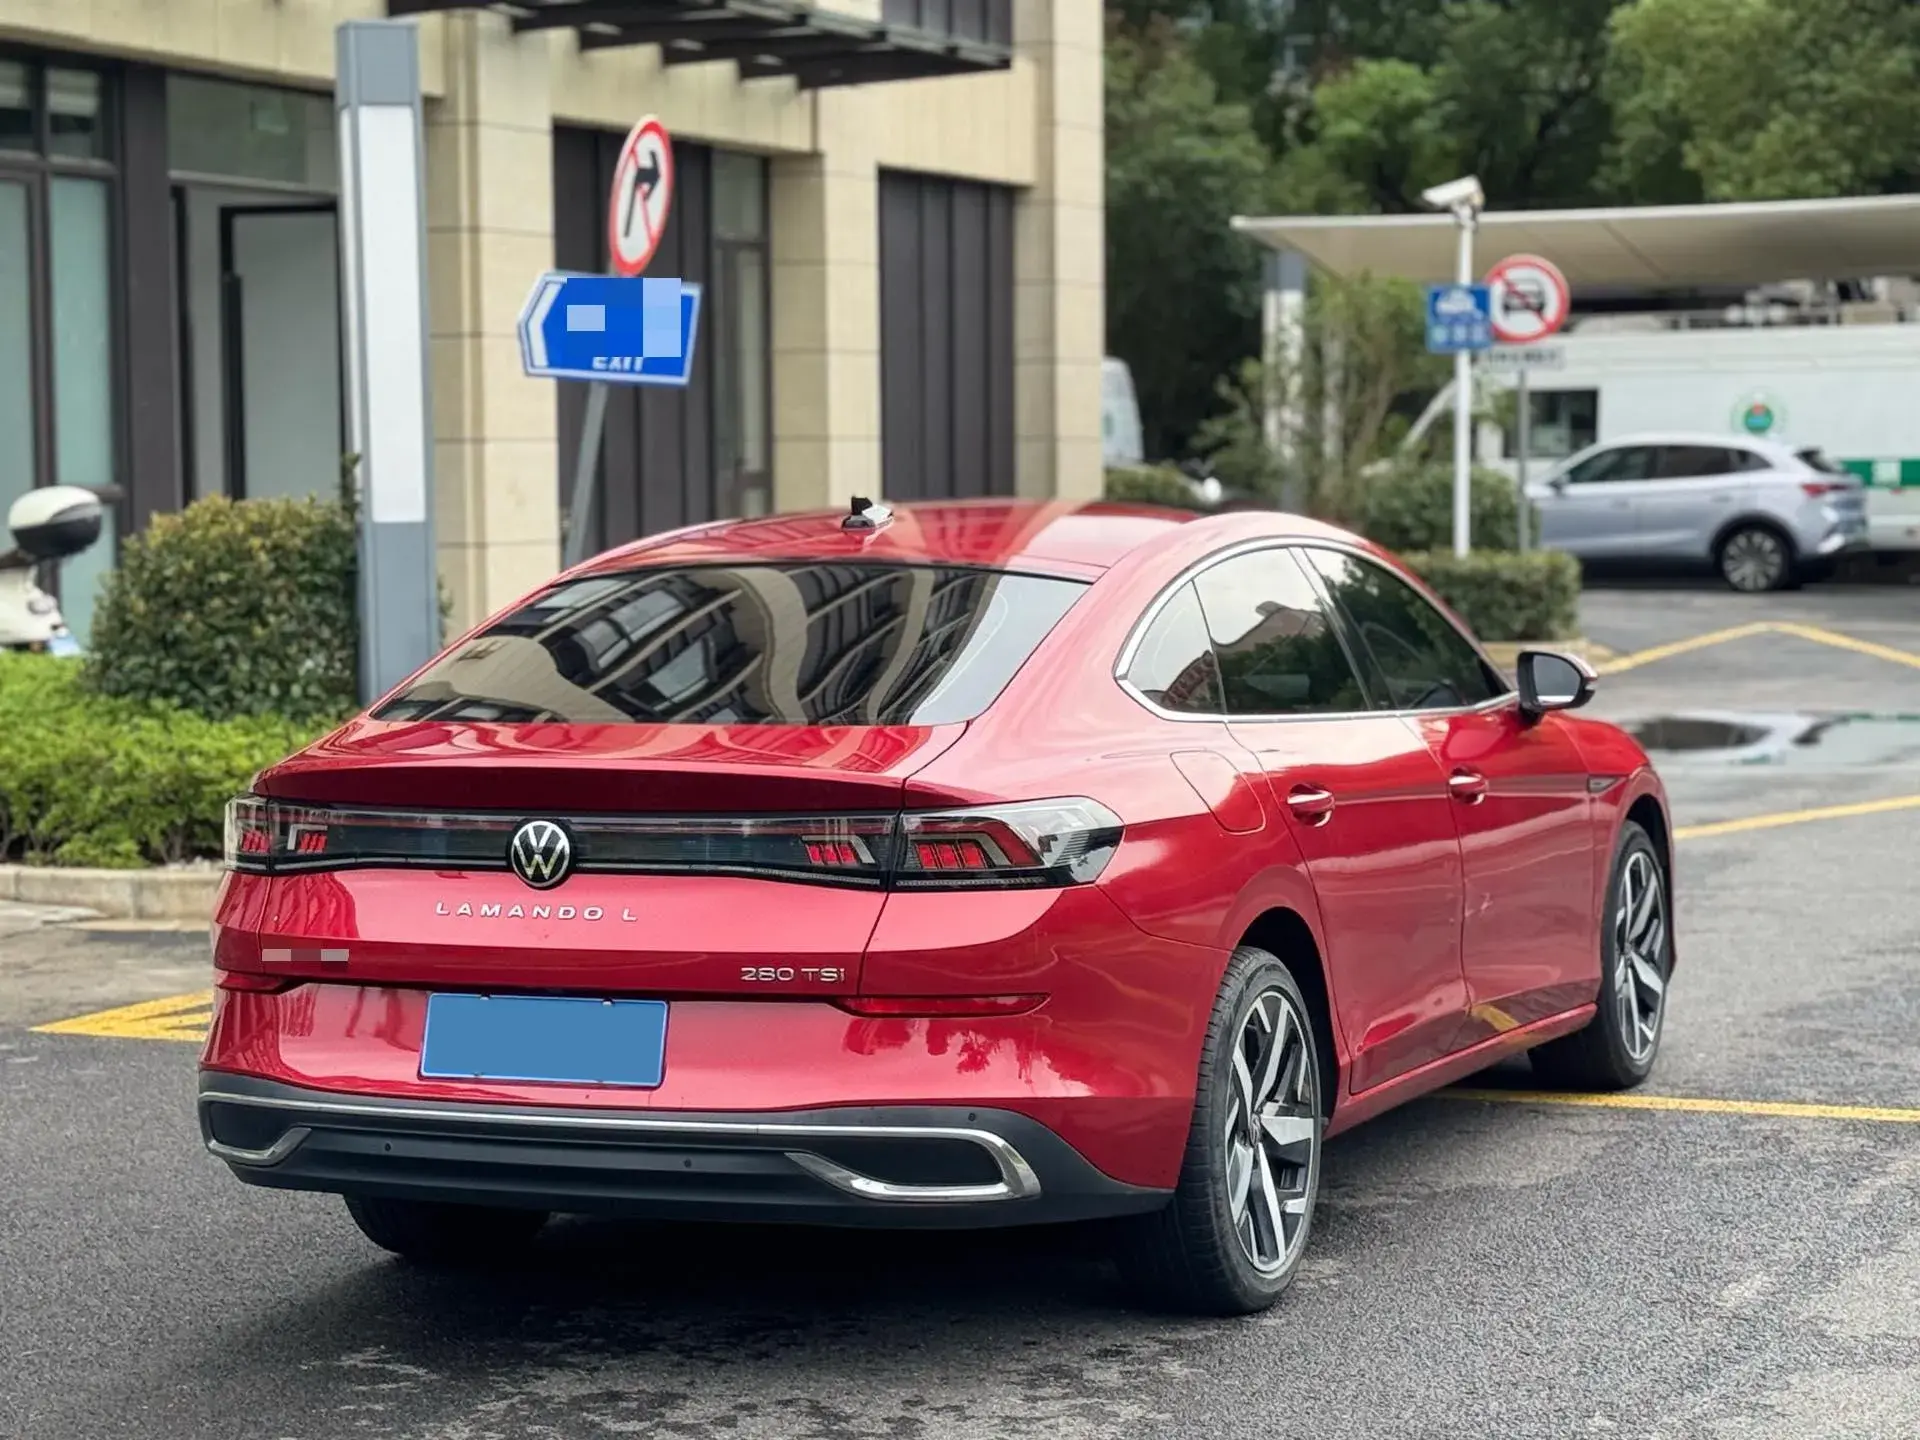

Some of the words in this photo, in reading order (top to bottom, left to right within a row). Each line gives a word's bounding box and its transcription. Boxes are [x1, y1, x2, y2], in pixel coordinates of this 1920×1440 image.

[435, 902, 604, 920] LAMANDO
[621, 908, 637, 922] L
[740, 966, 795, 982] 280
